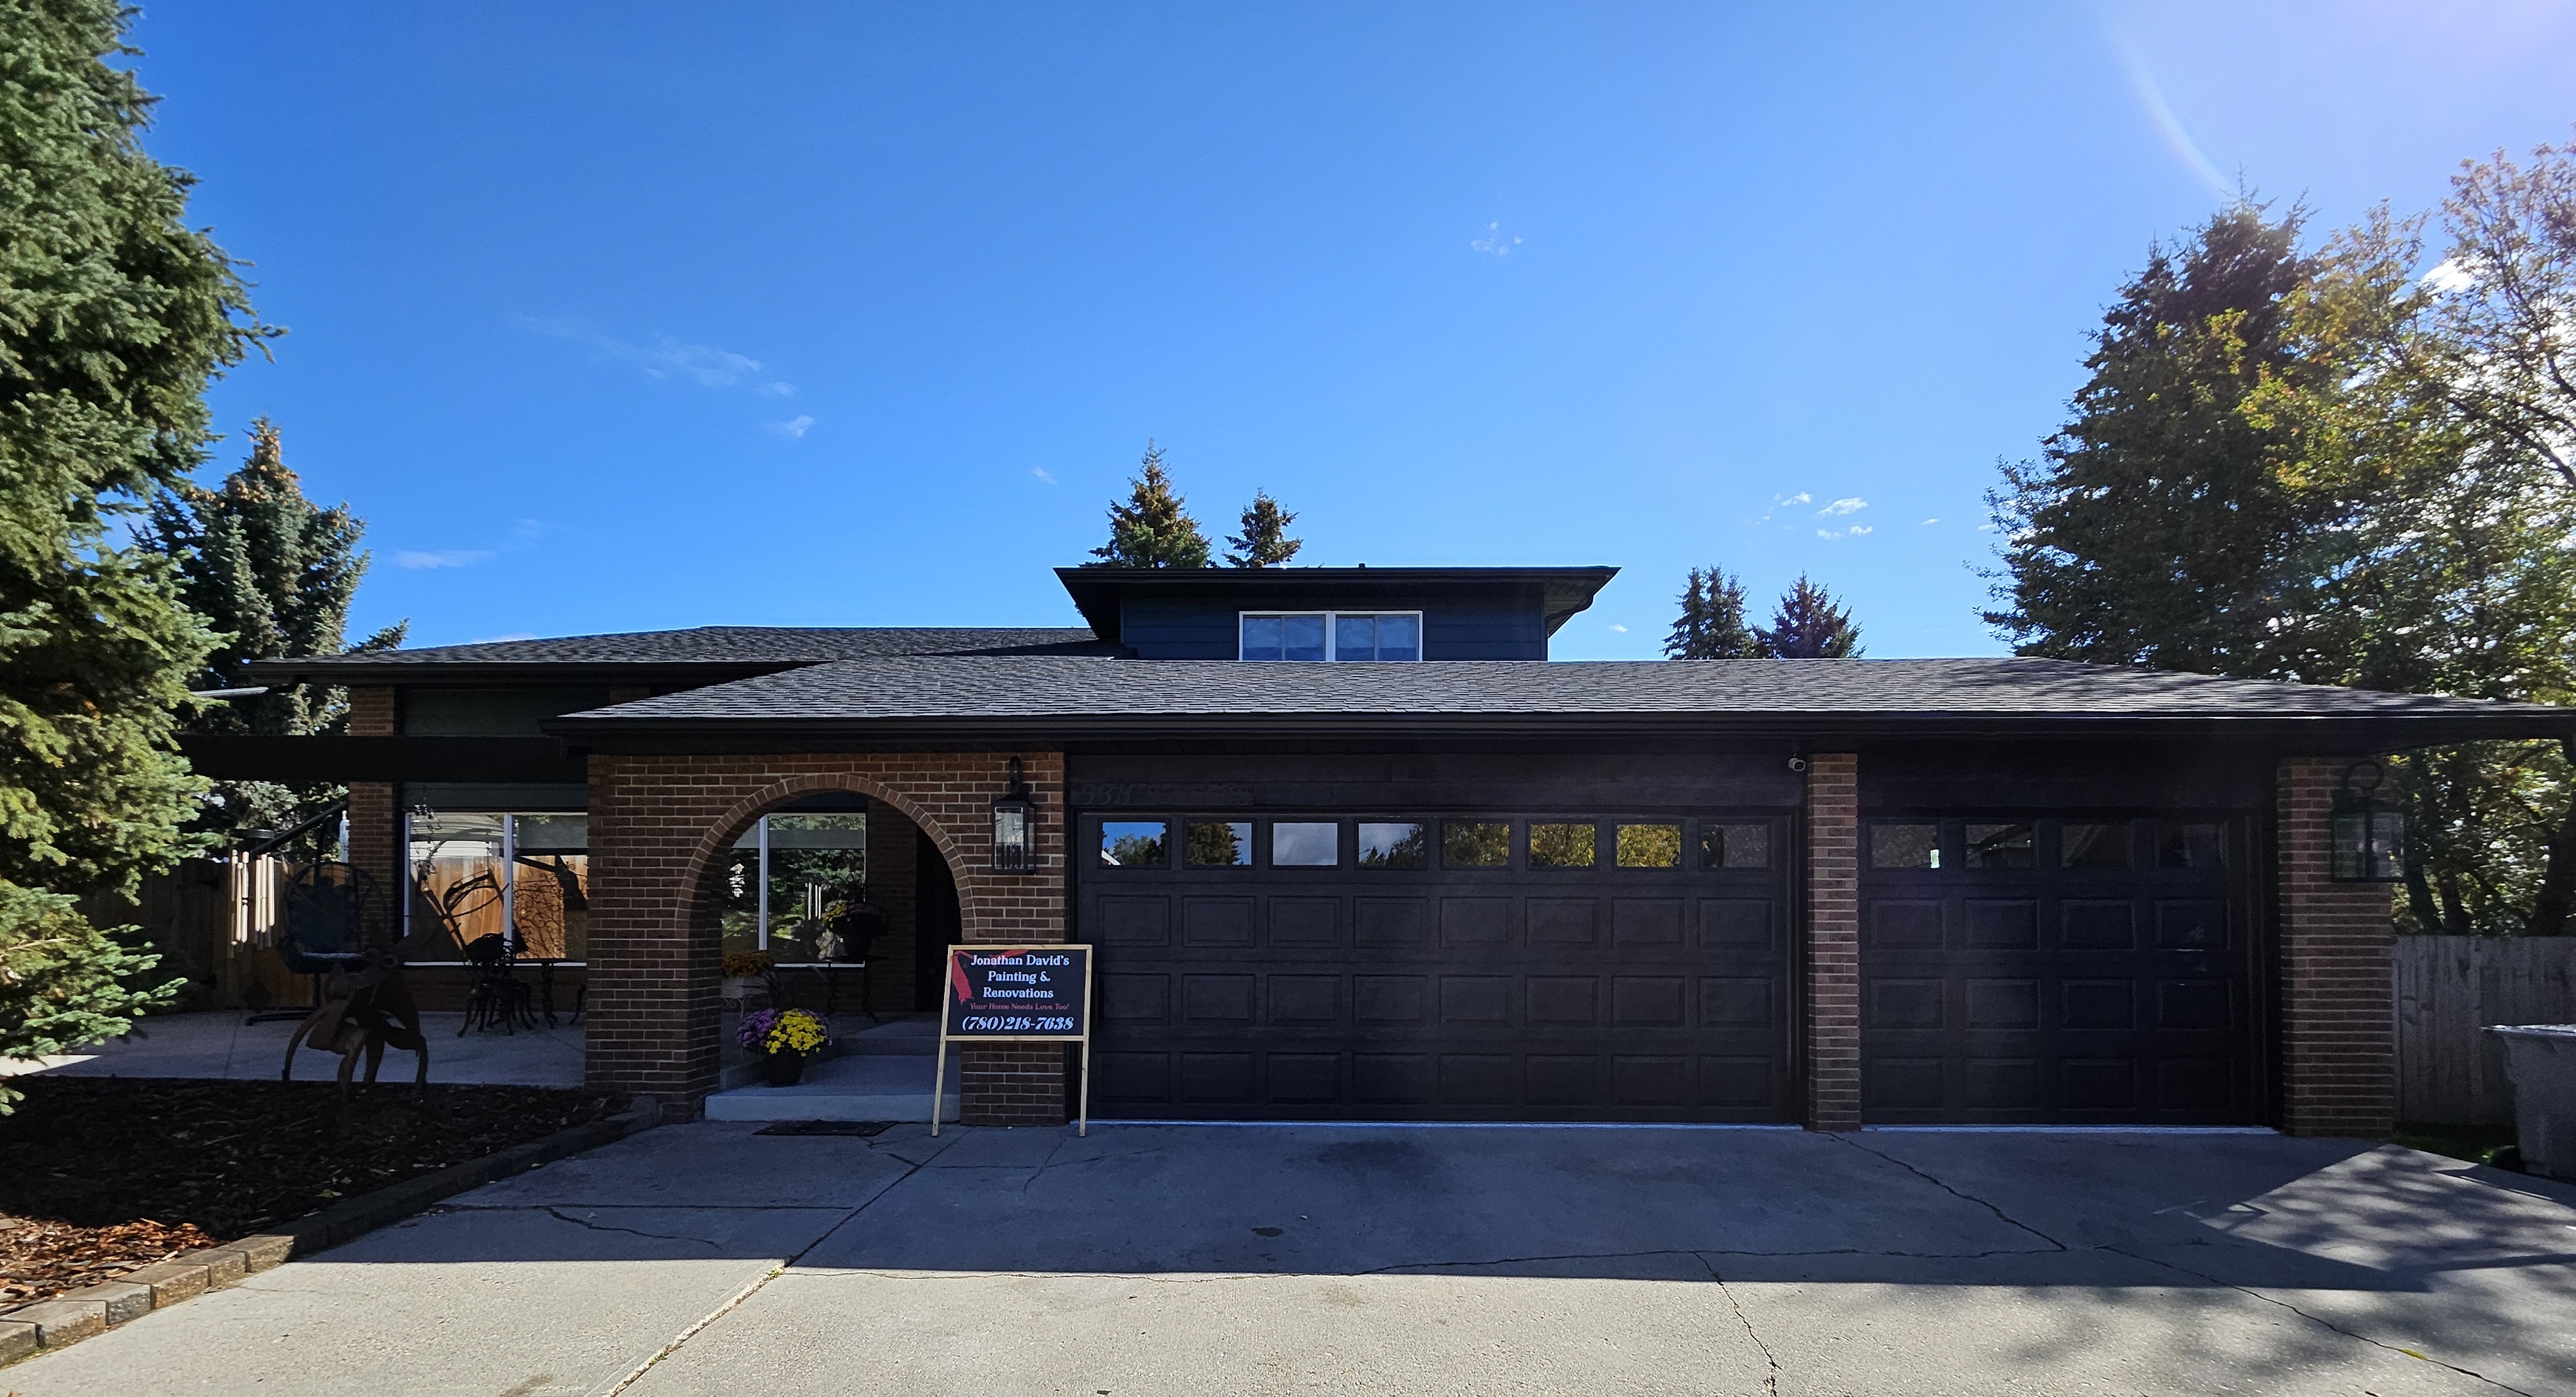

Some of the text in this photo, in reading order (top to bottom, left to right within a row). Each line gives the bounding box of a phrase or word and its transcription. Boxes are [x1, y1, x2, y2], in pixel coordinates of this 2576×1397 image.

[971, 954, 1070, 965] Jonathan David's
[988, 971, 1051, 984] Painting &
[983, 987, 1054, 998] Renovations
[962, 1016, 1074, 1031] (780)218-7638
